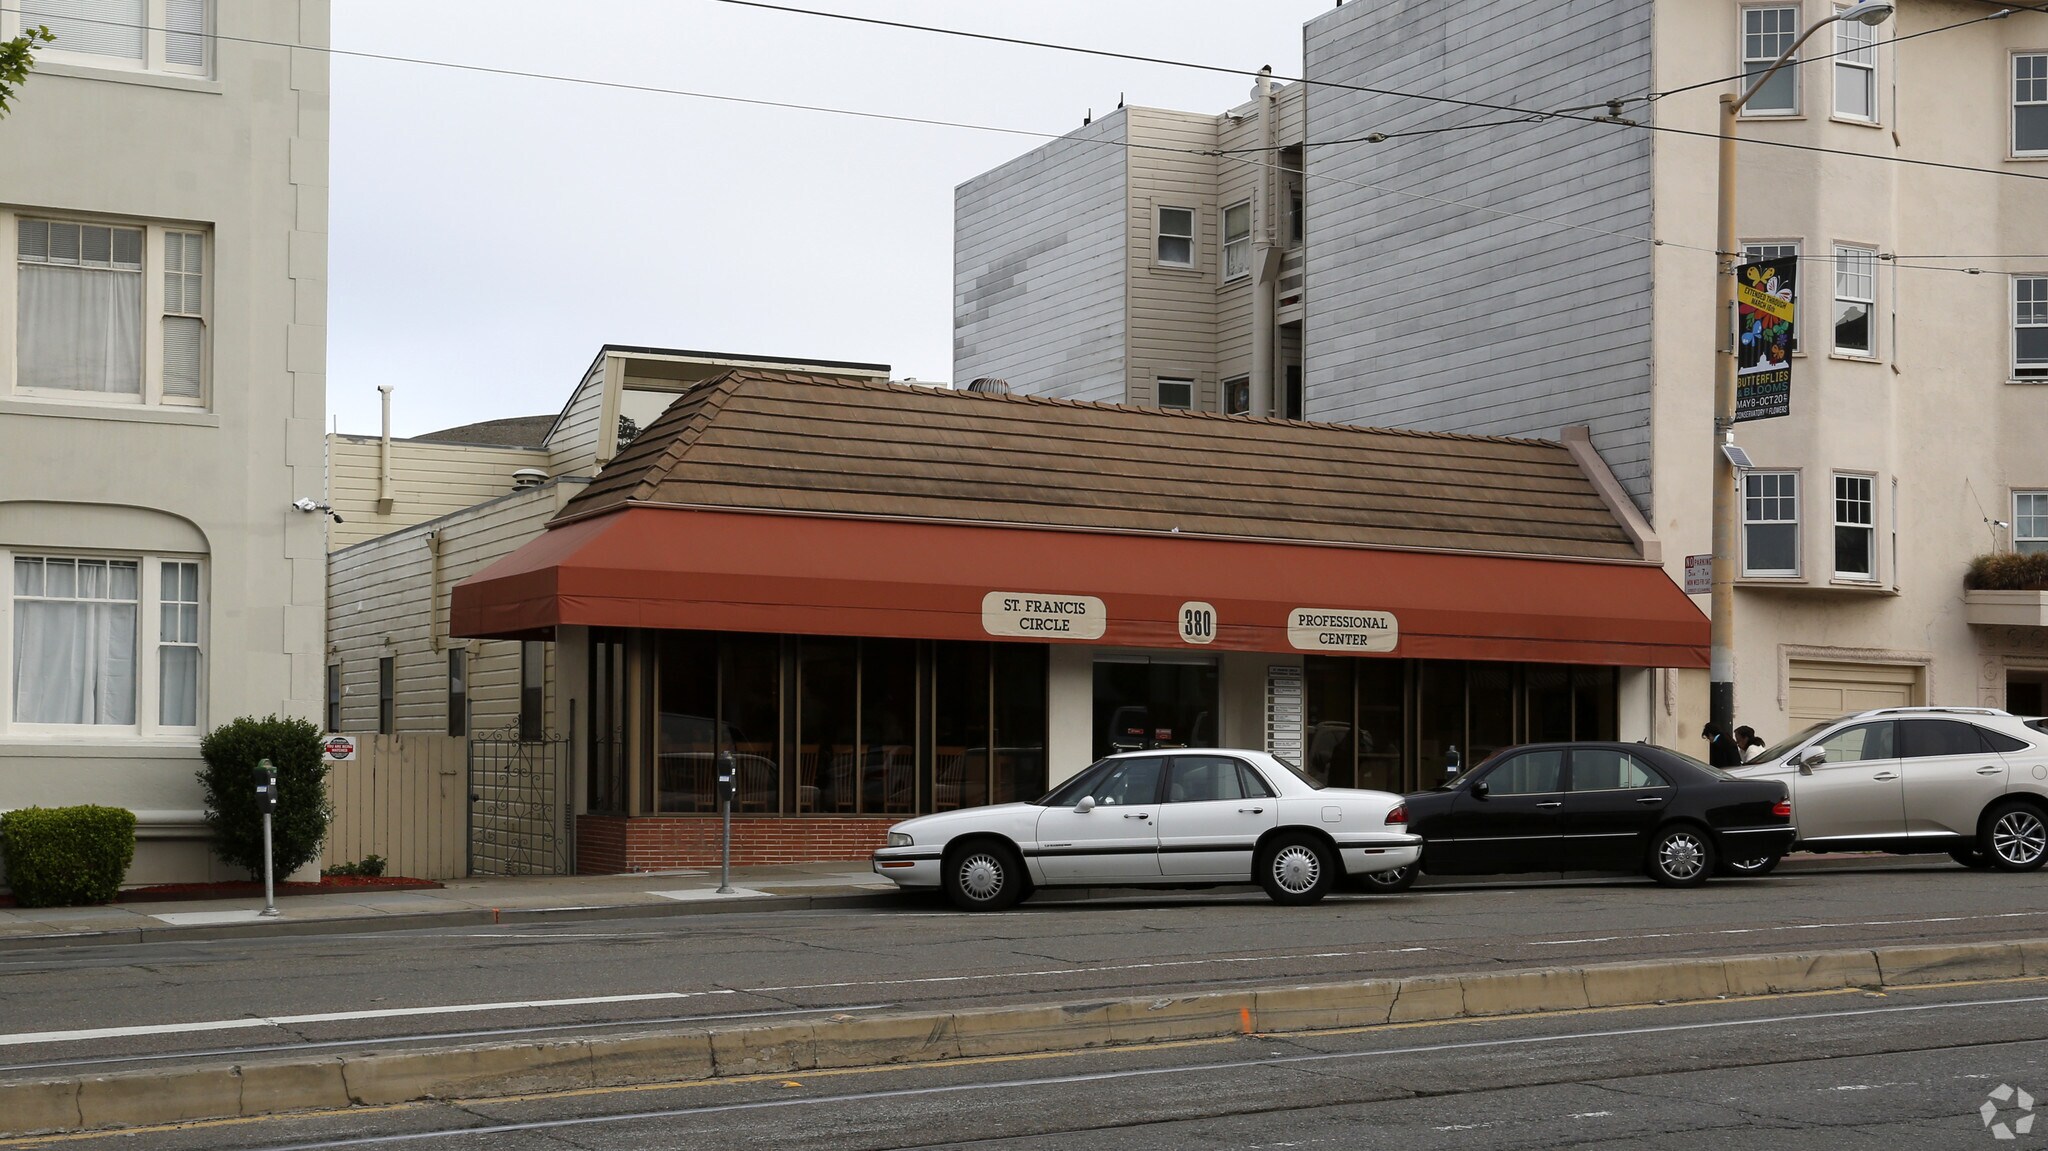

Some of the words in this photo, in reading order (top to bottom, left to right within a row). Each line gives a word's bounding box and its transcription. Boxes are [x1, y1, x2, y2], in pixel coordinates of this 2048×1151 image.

[1744, 287, 1766, 301] EXTENDED
[1737, 371, 1789, 388] BUTTERFLIES
[1743, 382, 1788, 397] BLOOMS
[1768, 405, 1787, 415] FLOWERS
[1685, 557, 1694, 567] NO
[1004, 598, 1021, 611] ST.
[1025, 600, 1086, 615] FRANCIS
[1019, 617, 1070, 631] CIRCLE
[1184, 609, 1211, 637] 380
[1298, 614, 1388, 630] PROFESSIONAL
[1319, 632, 1368, 646] CENTER
